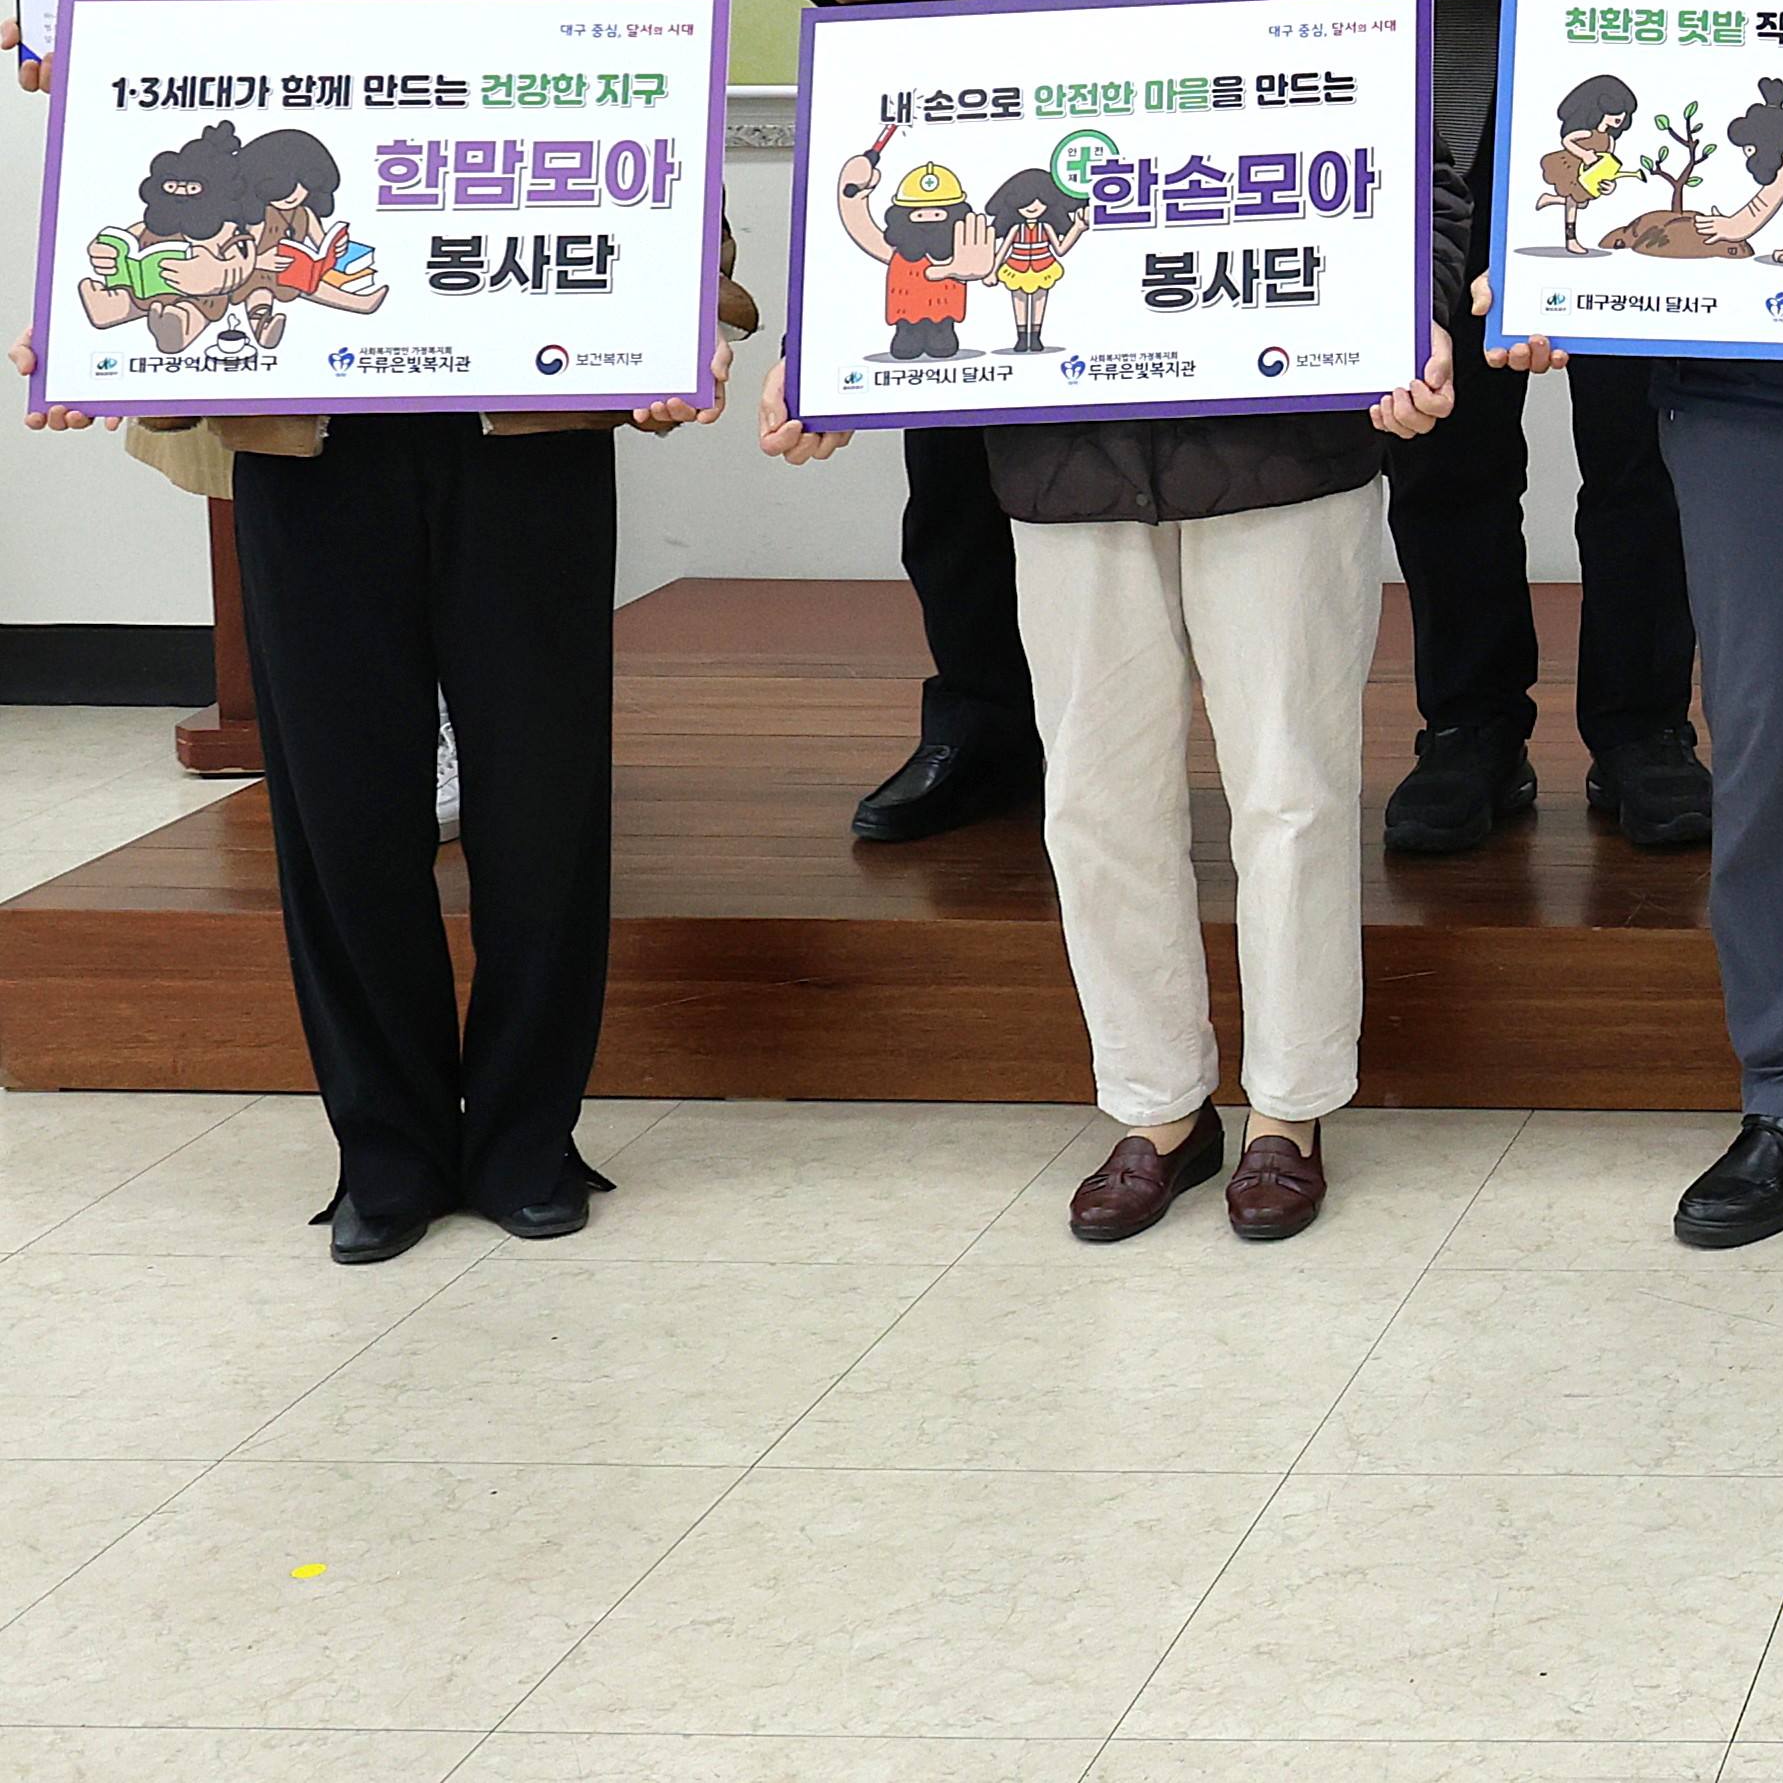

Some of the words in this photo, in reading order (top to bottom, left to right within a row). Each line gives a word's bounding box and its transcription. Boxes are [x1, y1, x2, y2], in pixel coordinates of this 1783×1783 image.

[560, 24, 586, 36] 대구
[592, 24, 621, 38] 중심,
[627, 24, 662, 37] 달서의
[668, 24, 693, 35] 시대
[1269, 25, 1293, 37] 대구
[1299, 24, 1327, 38] 중심,
[1332, 22, 1366, 36] 달서의
[1372, 20, 1396, 31] 시대
[1565, 7, 1667, 45] 친환경
[1678, 10, 1745, 46] 텃밭
[112, 75, 270, 108] 1·3세대가
[282, 75, 350, 107] 함께
[364, 75, 467, 106] 만드는
[481, 73, 589, 108] 건강한
[596, 73, 668, 106] 지구
[881, 92, 912, 129] 내
[924, 87, 1021, 122] 손으로
[1035, 81, 1134, 118] 안전한
[1146, 76, 1243, 110] 마을을
[1256, 71, 1354, 106] 만드는
[1067, 148, 1078, 158] 안
[1093, 145, 1104, 156] 전
[375, 138, 682, 212] 한맘모아
[1091, 147, 1381, 228] 한손모아
[427, 235, 614, 296] 봉사단
[1142, 246, 1325, 313] 봉사단
[1577, 295, 1660, 312] 대구광역시
[1666, 297, 1717, 313] 달서구
[413, 347, 452, 355] 가정복지회
[576, 353, 642, 366] 보건복지부
[1091, 354, 1136, 362] 사회복지법인
[1140, 352, 1177, 361] 가정복지회
[1297, 352, 1359, 367] 보건복지부
[130, 351, 222, 373] 대구광역시
[219, 351, 277, 372] 달서구
[357, 356, 470, 373] 두류은빛복지관
[1088, 356, 1196, 380] 두류은빛복지관
[875, 368, 956, 386] 대구광역시
[963, 366, 1013, 383] 달서구
